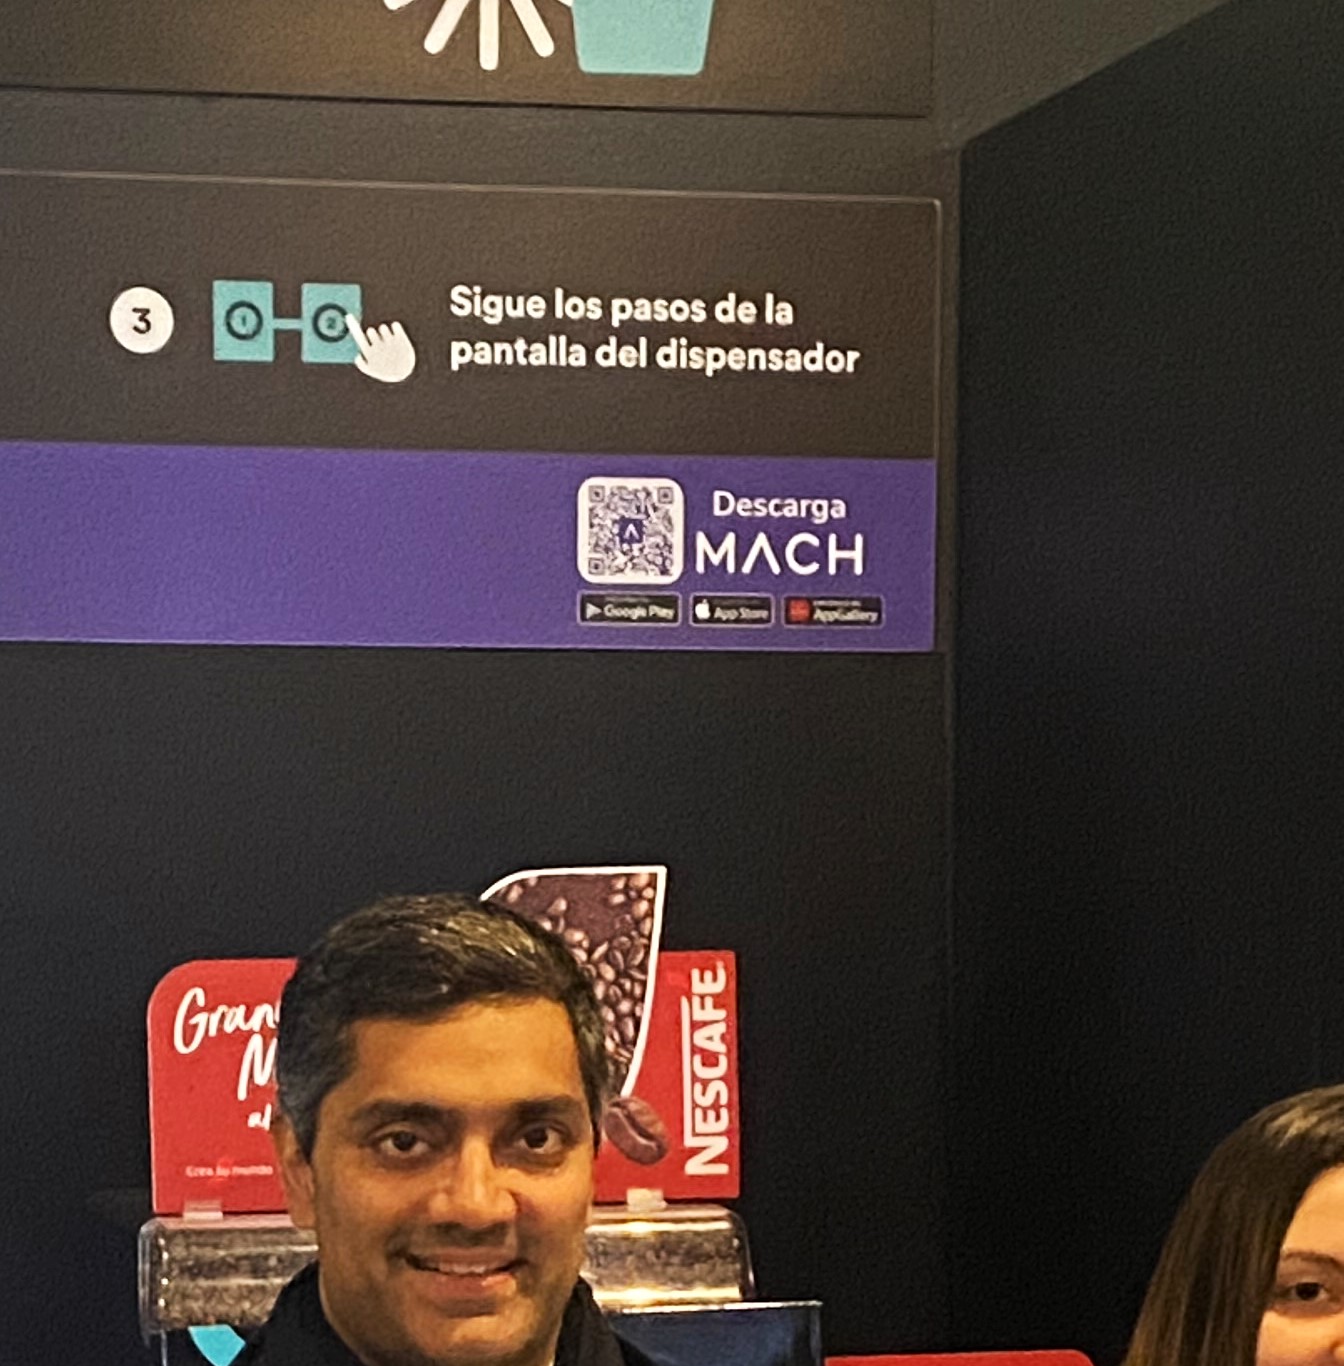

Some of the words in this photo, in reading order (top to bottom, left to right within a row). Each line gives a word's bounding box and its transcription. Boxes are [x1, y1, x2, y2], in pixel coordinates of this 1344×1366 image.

[131, 307, 152, 335] 3
[450, 284, 547, 325] Sigue
[554, 287, 603, 321] los
[611, 298, 707, 328] pasos
[714, 292, 758, 325] de
[764, 292, 794, 326] la
[450, 334, 587, 372] pantalla
[594, 335, 648, 368] del
[655, 337, 861, 378] dispensador
[713, 490, 846, 525] Descarga
[695, 530, 864, 576] MACH
